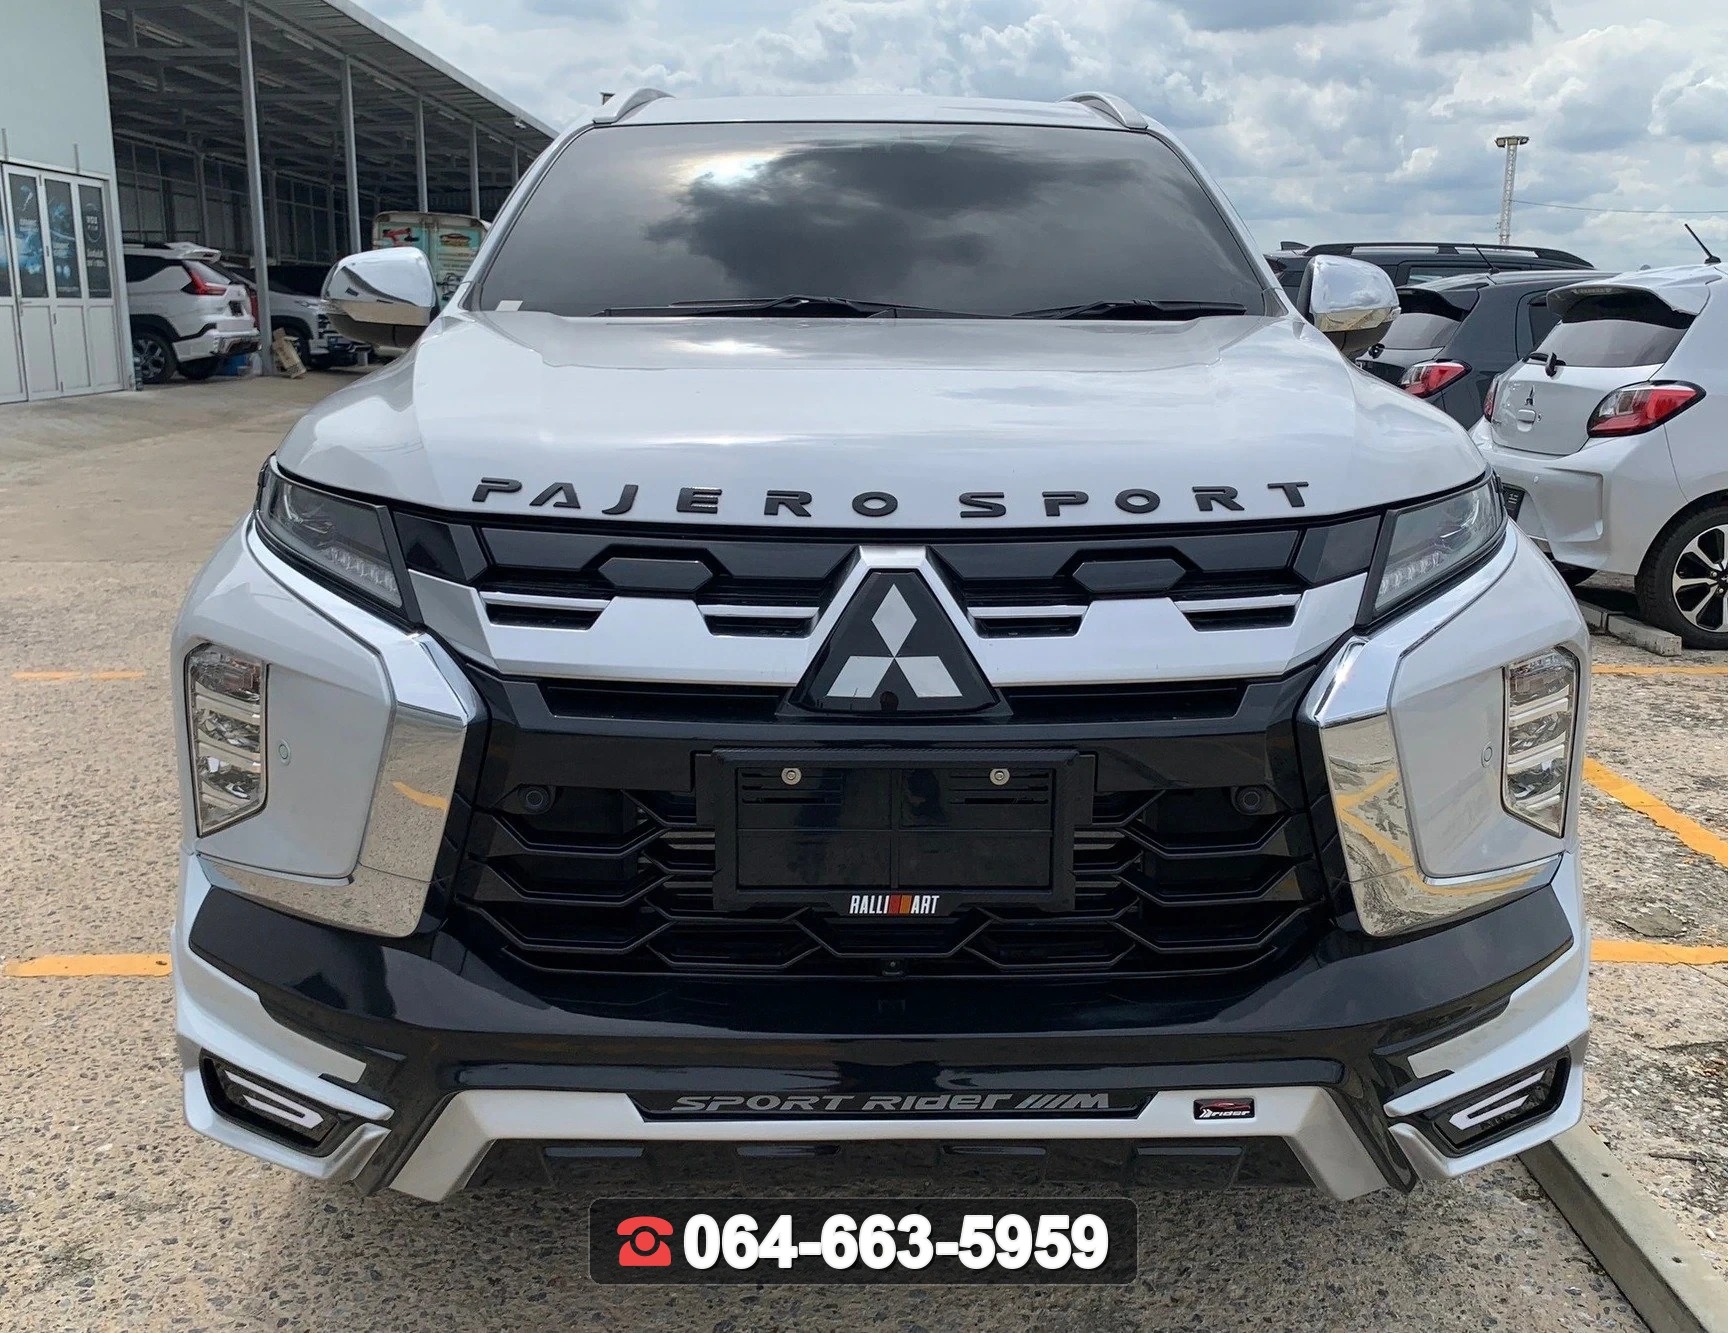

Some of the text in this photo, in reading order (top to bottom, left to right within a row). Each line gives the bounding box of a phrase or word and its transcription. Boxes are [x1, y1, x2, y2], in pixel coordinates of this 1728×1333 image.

[472, 477, 1309, 518] PAJERO SPORT
[671, 1095, 855, 1111] SPORT
